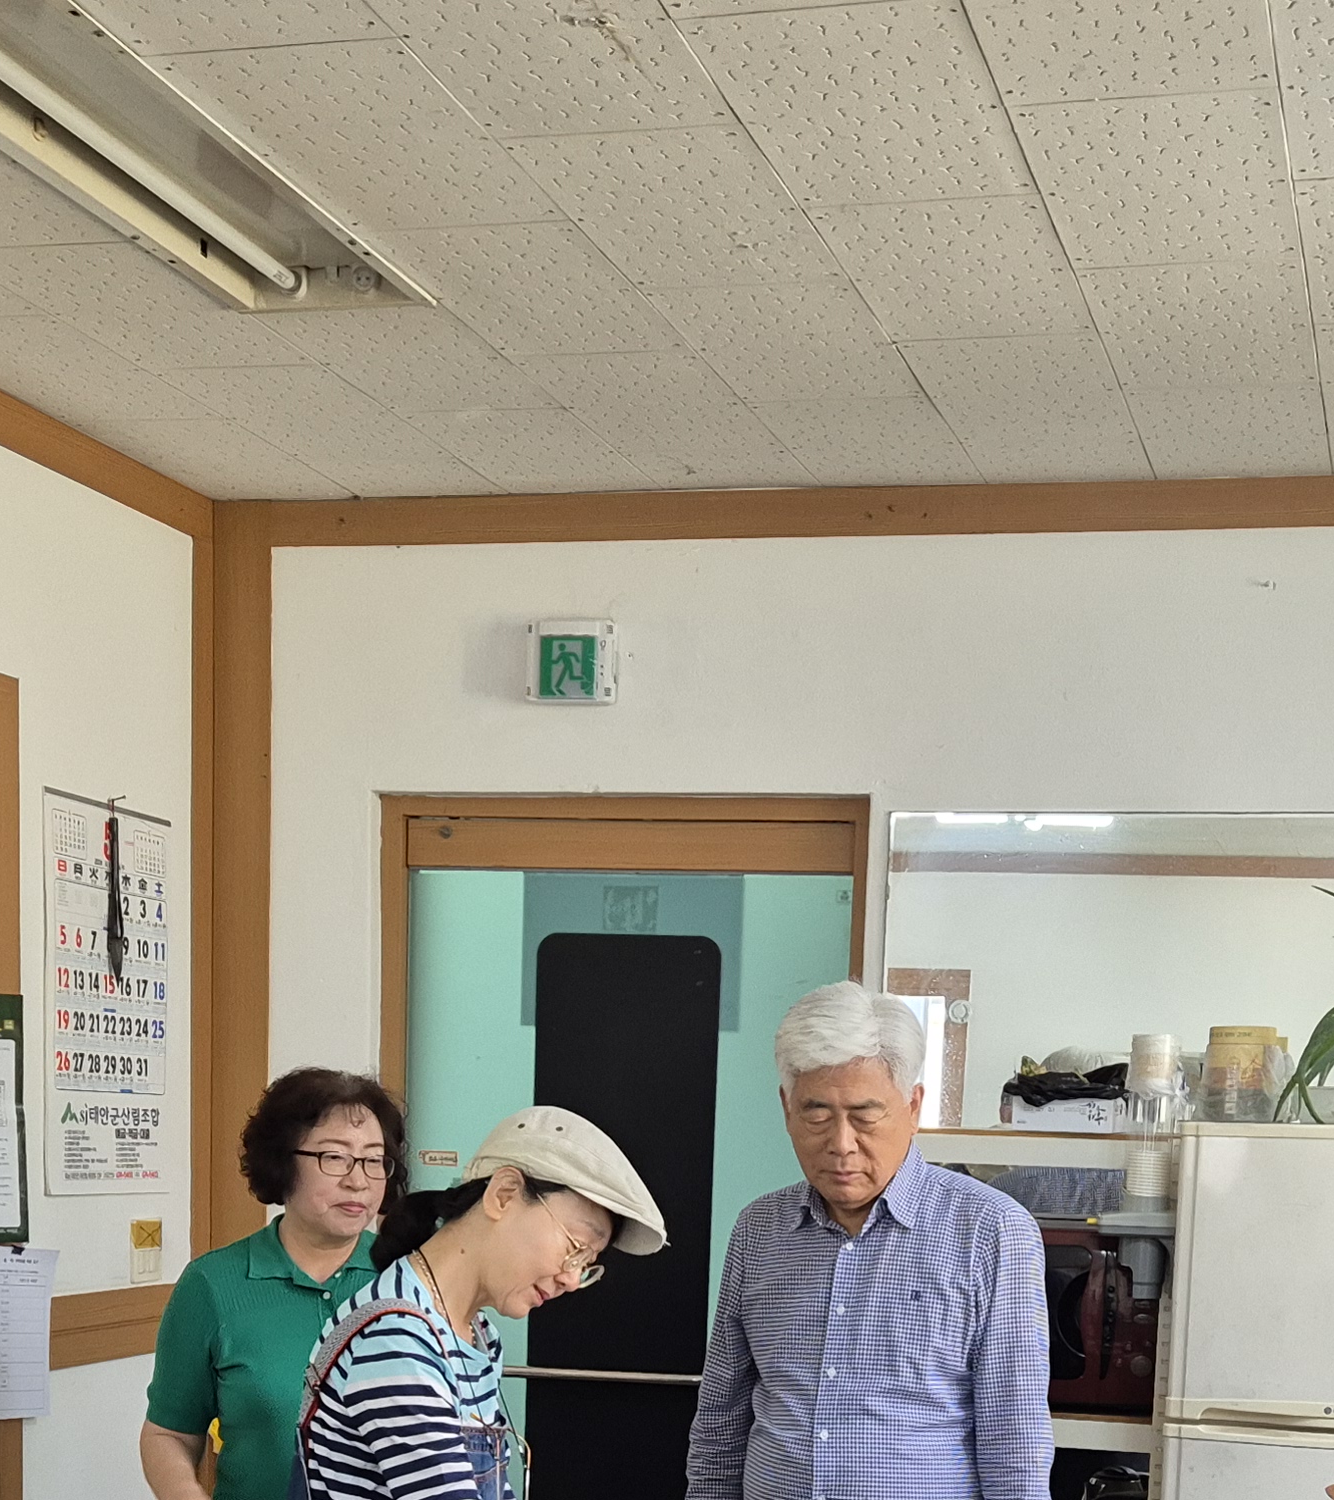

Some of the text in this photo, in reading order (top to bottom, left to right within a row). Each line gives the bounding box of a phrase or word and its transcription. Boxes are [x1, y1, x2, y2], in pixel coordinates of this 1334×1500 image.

[123, 896, 163, 922] 2 3 4
[60, 925, 67, 945] 5
[75, 927, 82, 948] 6
[90, 930, 97, 950] 7
[137, 938, 149, 959] 10
[154, 942, 165, 961] 11
[57, 967, 165, 1000] 12 13 14 15 16 17 18
[57, 1009, 165, 1039] 19 20 21 22 23 24 25
[56, 1050, 148, 1077] 26 27 28 29 30 31
